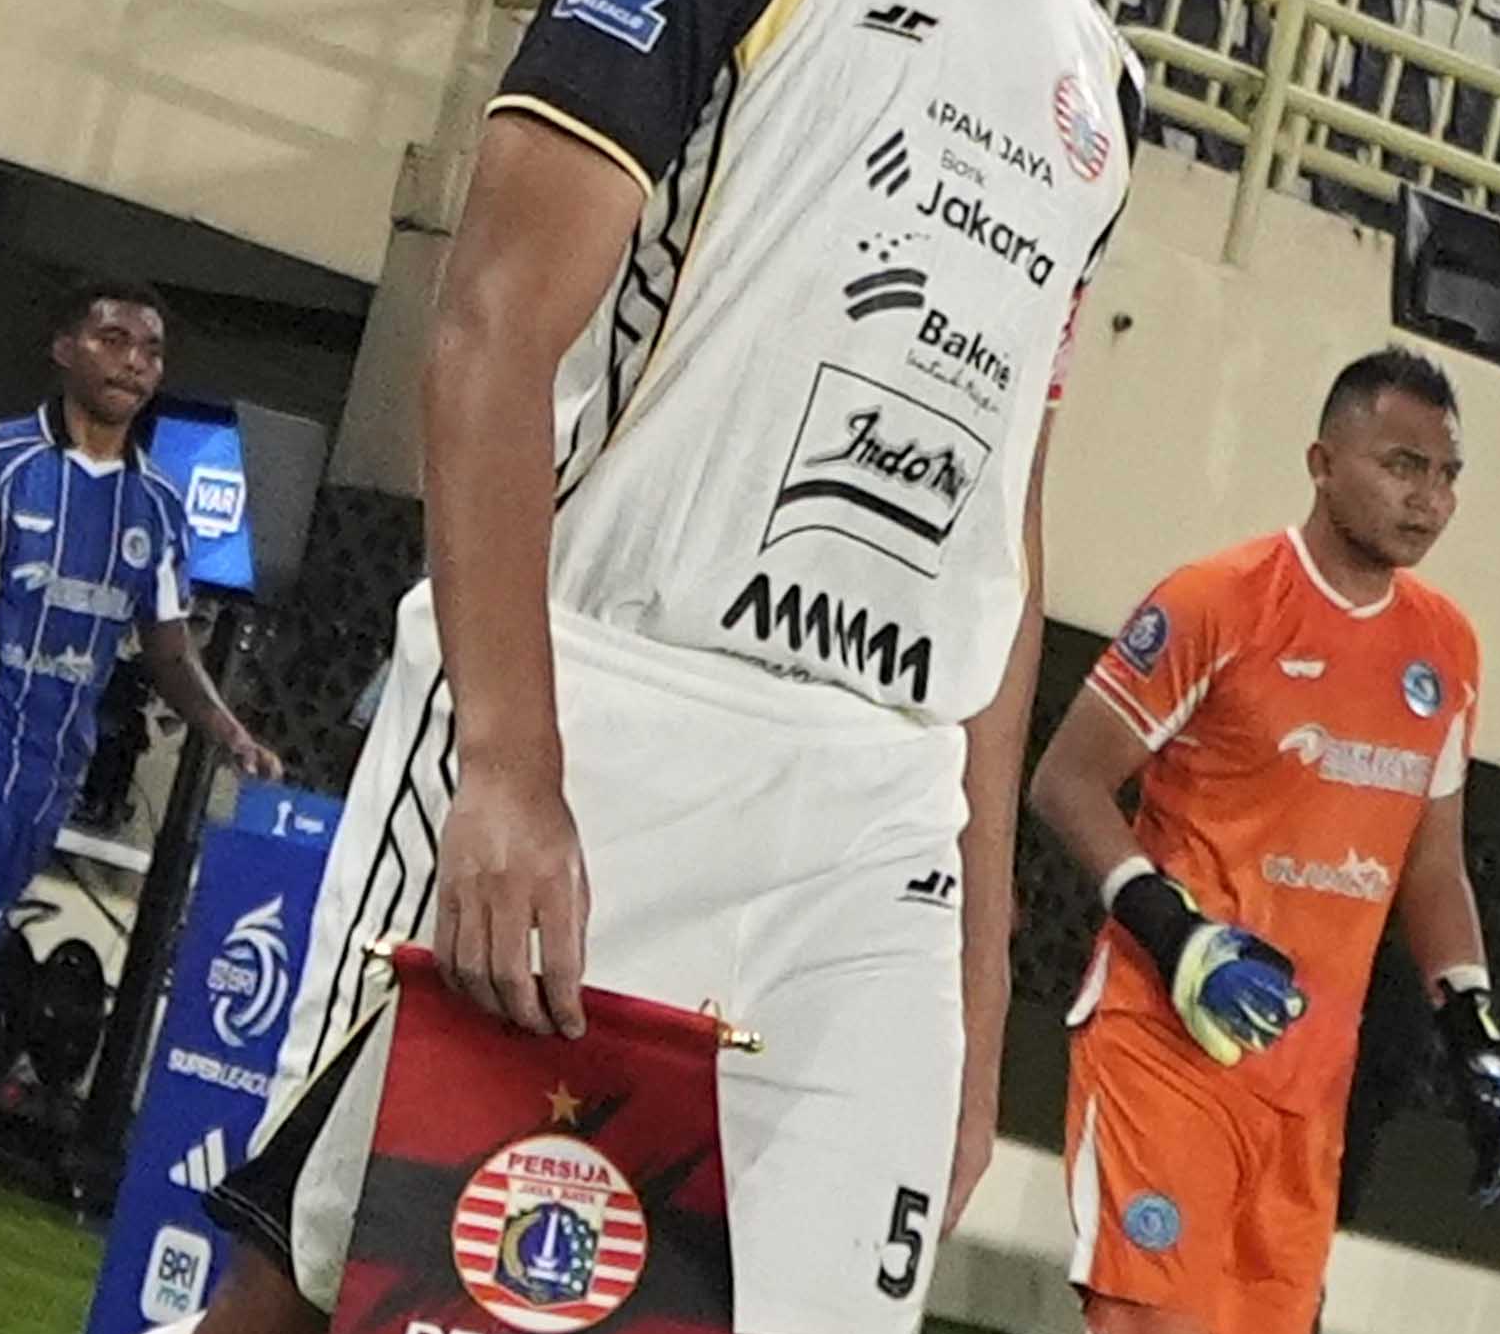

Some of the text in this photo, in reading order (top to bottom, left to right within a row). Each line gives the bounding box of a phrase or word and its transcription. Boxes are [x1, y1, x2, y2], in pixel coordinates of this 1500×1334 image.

[939, 102, 1055, 189] PAM JAYA
[196, 480, 236, 515] VAR
[507, 1151, 612, 1187] PERSIJA
[876, 1185, 930, 1301] 5
[158, 1247, 200, 1290] BRI
